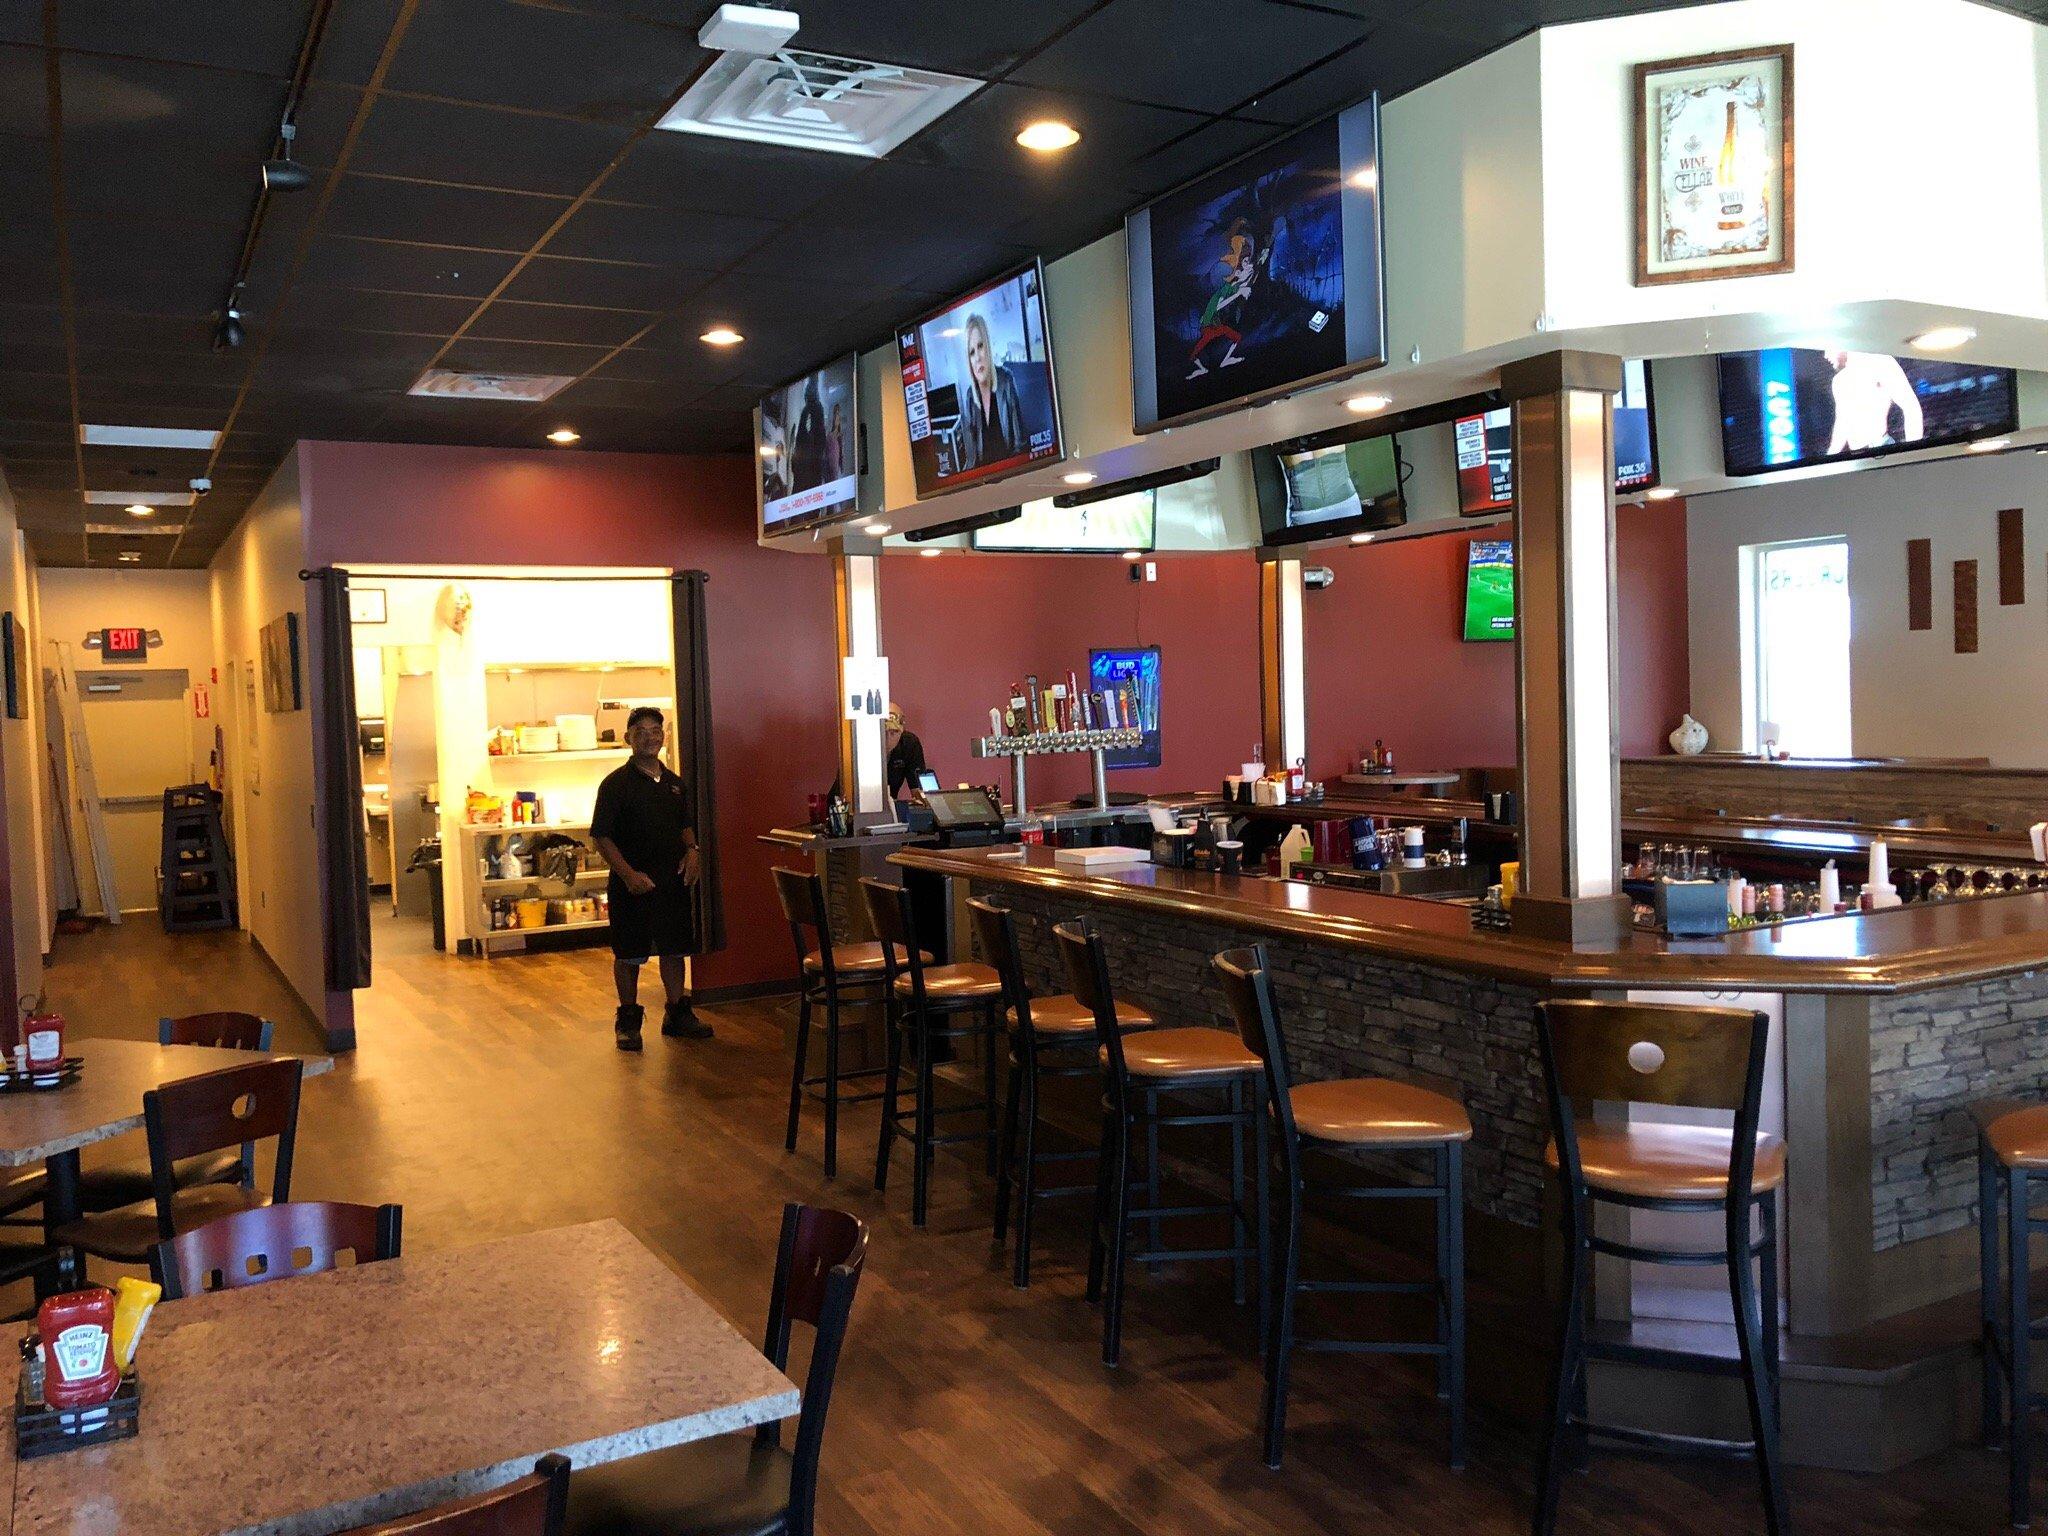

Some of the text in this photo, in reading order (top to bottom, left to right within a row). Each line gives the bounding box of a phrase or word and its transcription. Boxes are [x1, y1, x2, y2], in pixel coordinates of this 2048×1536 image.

[1680, 156, 1707, 169] WINE
[1675, 171, 1712, 193] CELLAR
[109, 630, 139, 649] EXIT
[1116, 662, 1135, 670] BUD
[1113, 669, 1138, 678] LIGT
[70, 1332, 93, 1341] HEINZ
[69, 1342, 96, 1350] TOMATO
